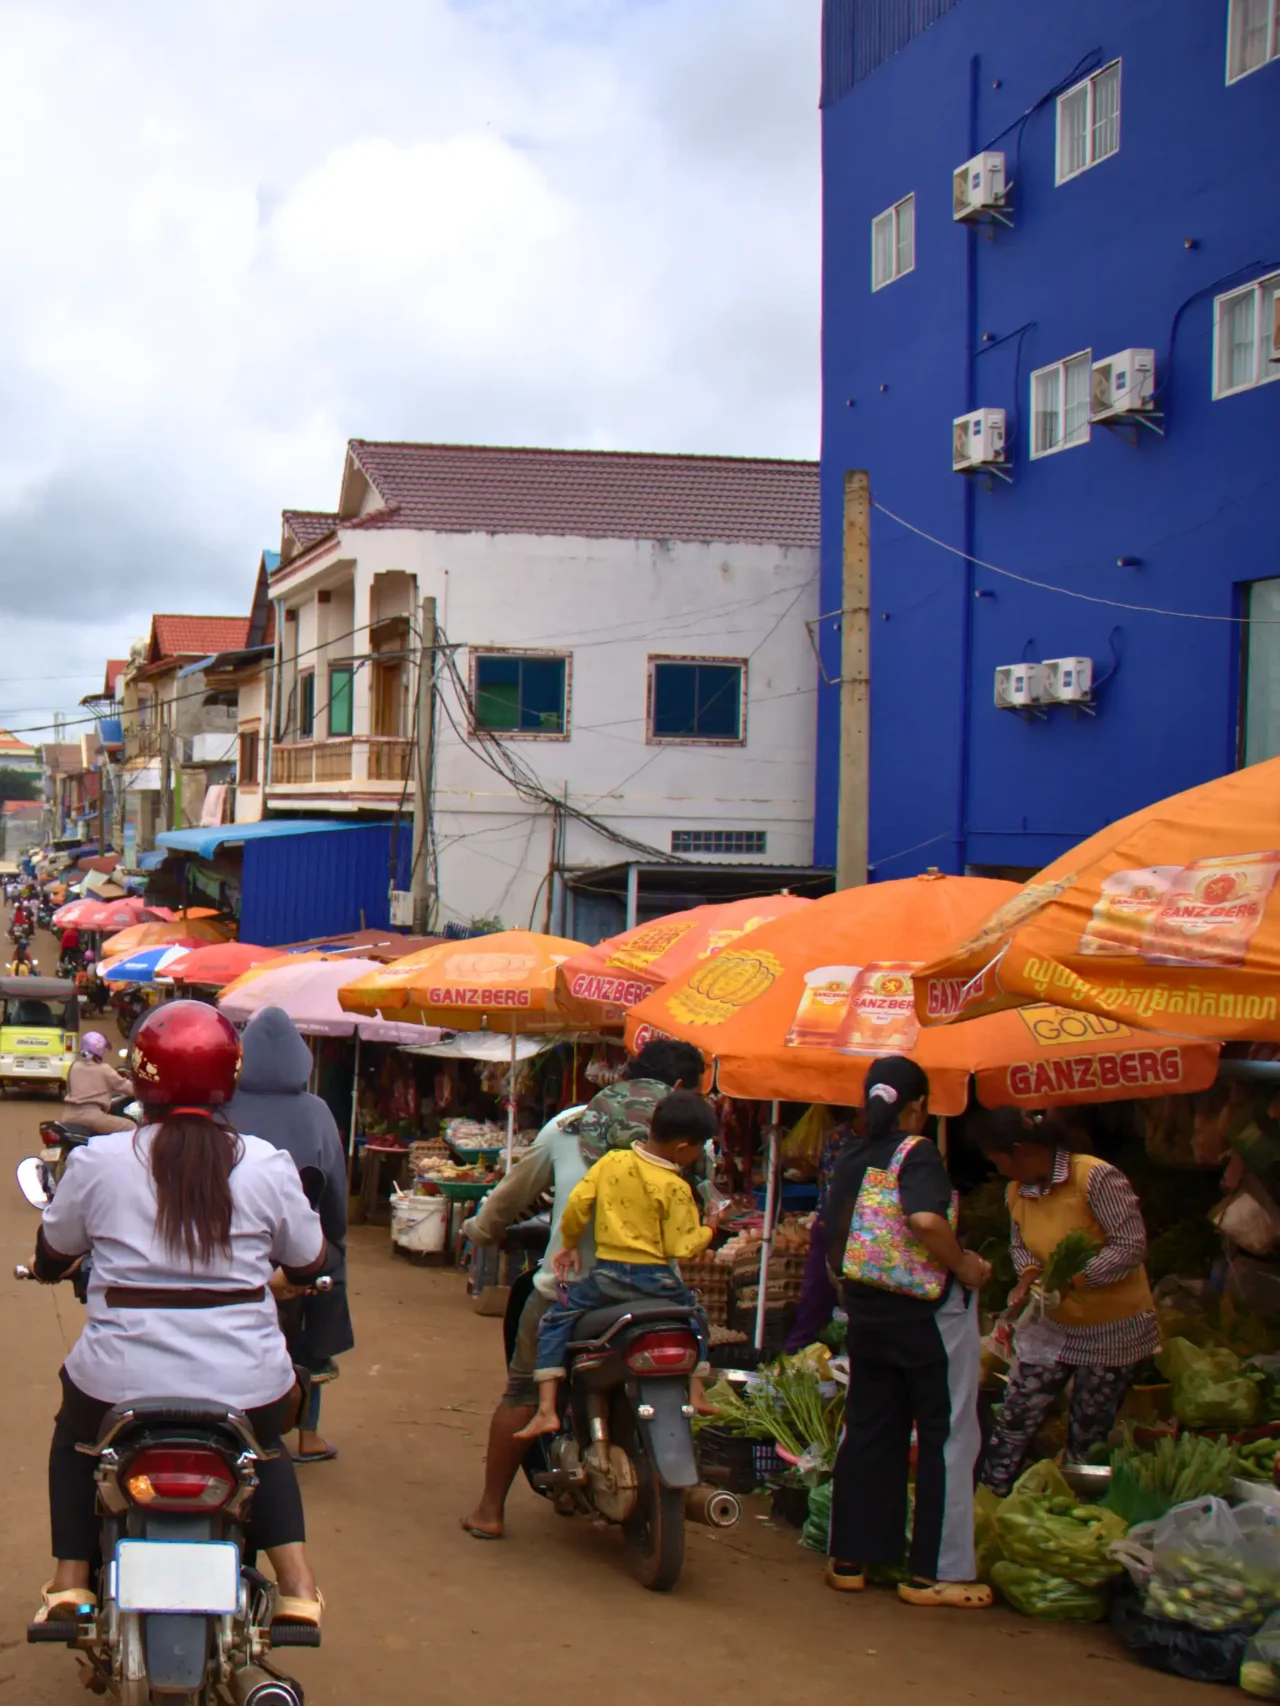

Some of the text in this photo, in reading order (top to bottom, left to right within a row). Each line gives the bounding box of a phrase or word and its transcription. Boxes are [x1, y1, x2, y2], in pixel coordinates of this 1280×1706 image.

[1160, 902, 1260, 918] GANZBERG
[429, 987, 529, 1006] GANZBERG
[852, 998, 914, 1010] GANZBER
[1033, 1013, 1120, 1040] GOLD
[1009, 1049, 1180, 1096] GANZBERG
